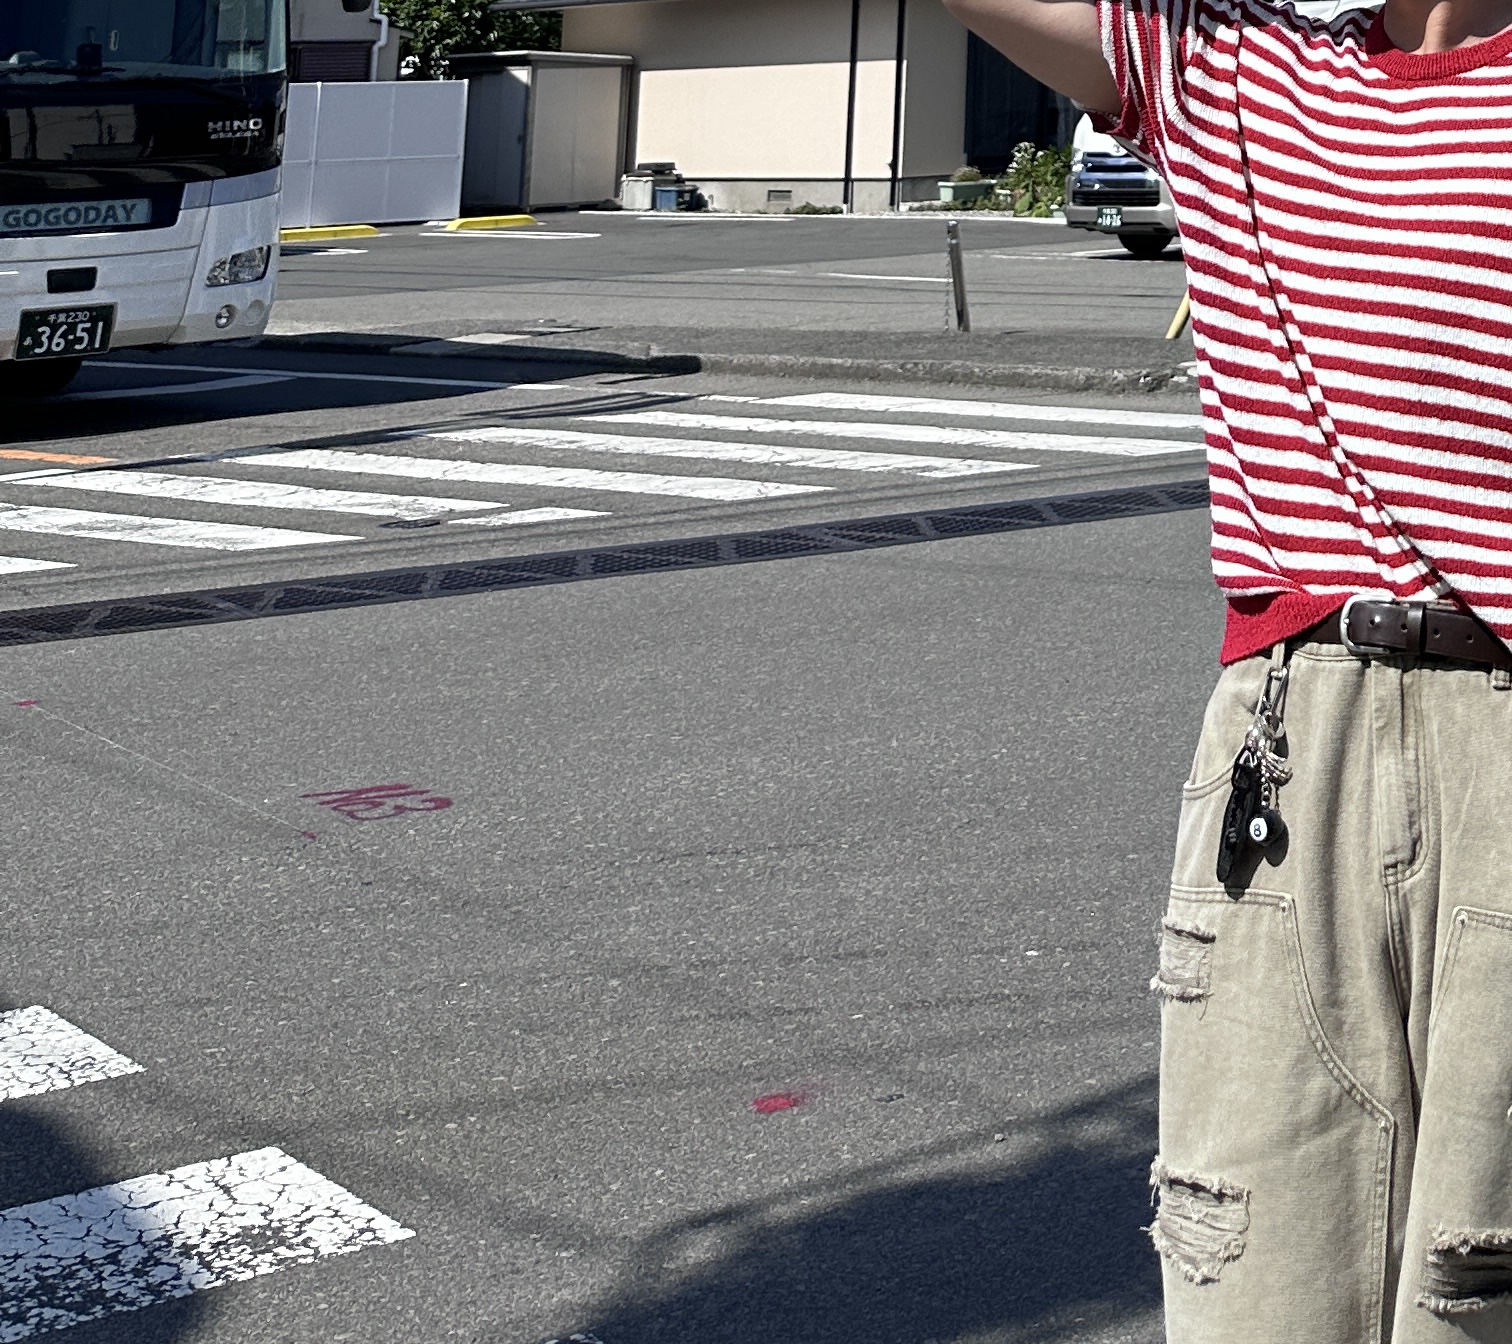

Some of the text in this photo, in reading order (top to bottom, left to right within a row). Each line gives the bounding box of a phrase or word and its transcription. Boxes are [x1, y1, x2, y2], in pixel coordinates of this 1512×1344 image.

[207, 118, 262, 132] HINO
[2, 203, 138, 229] GOGODAY
[33, 321, 104, 354] 36-51
[1253, 823, 1261, 837] 8
